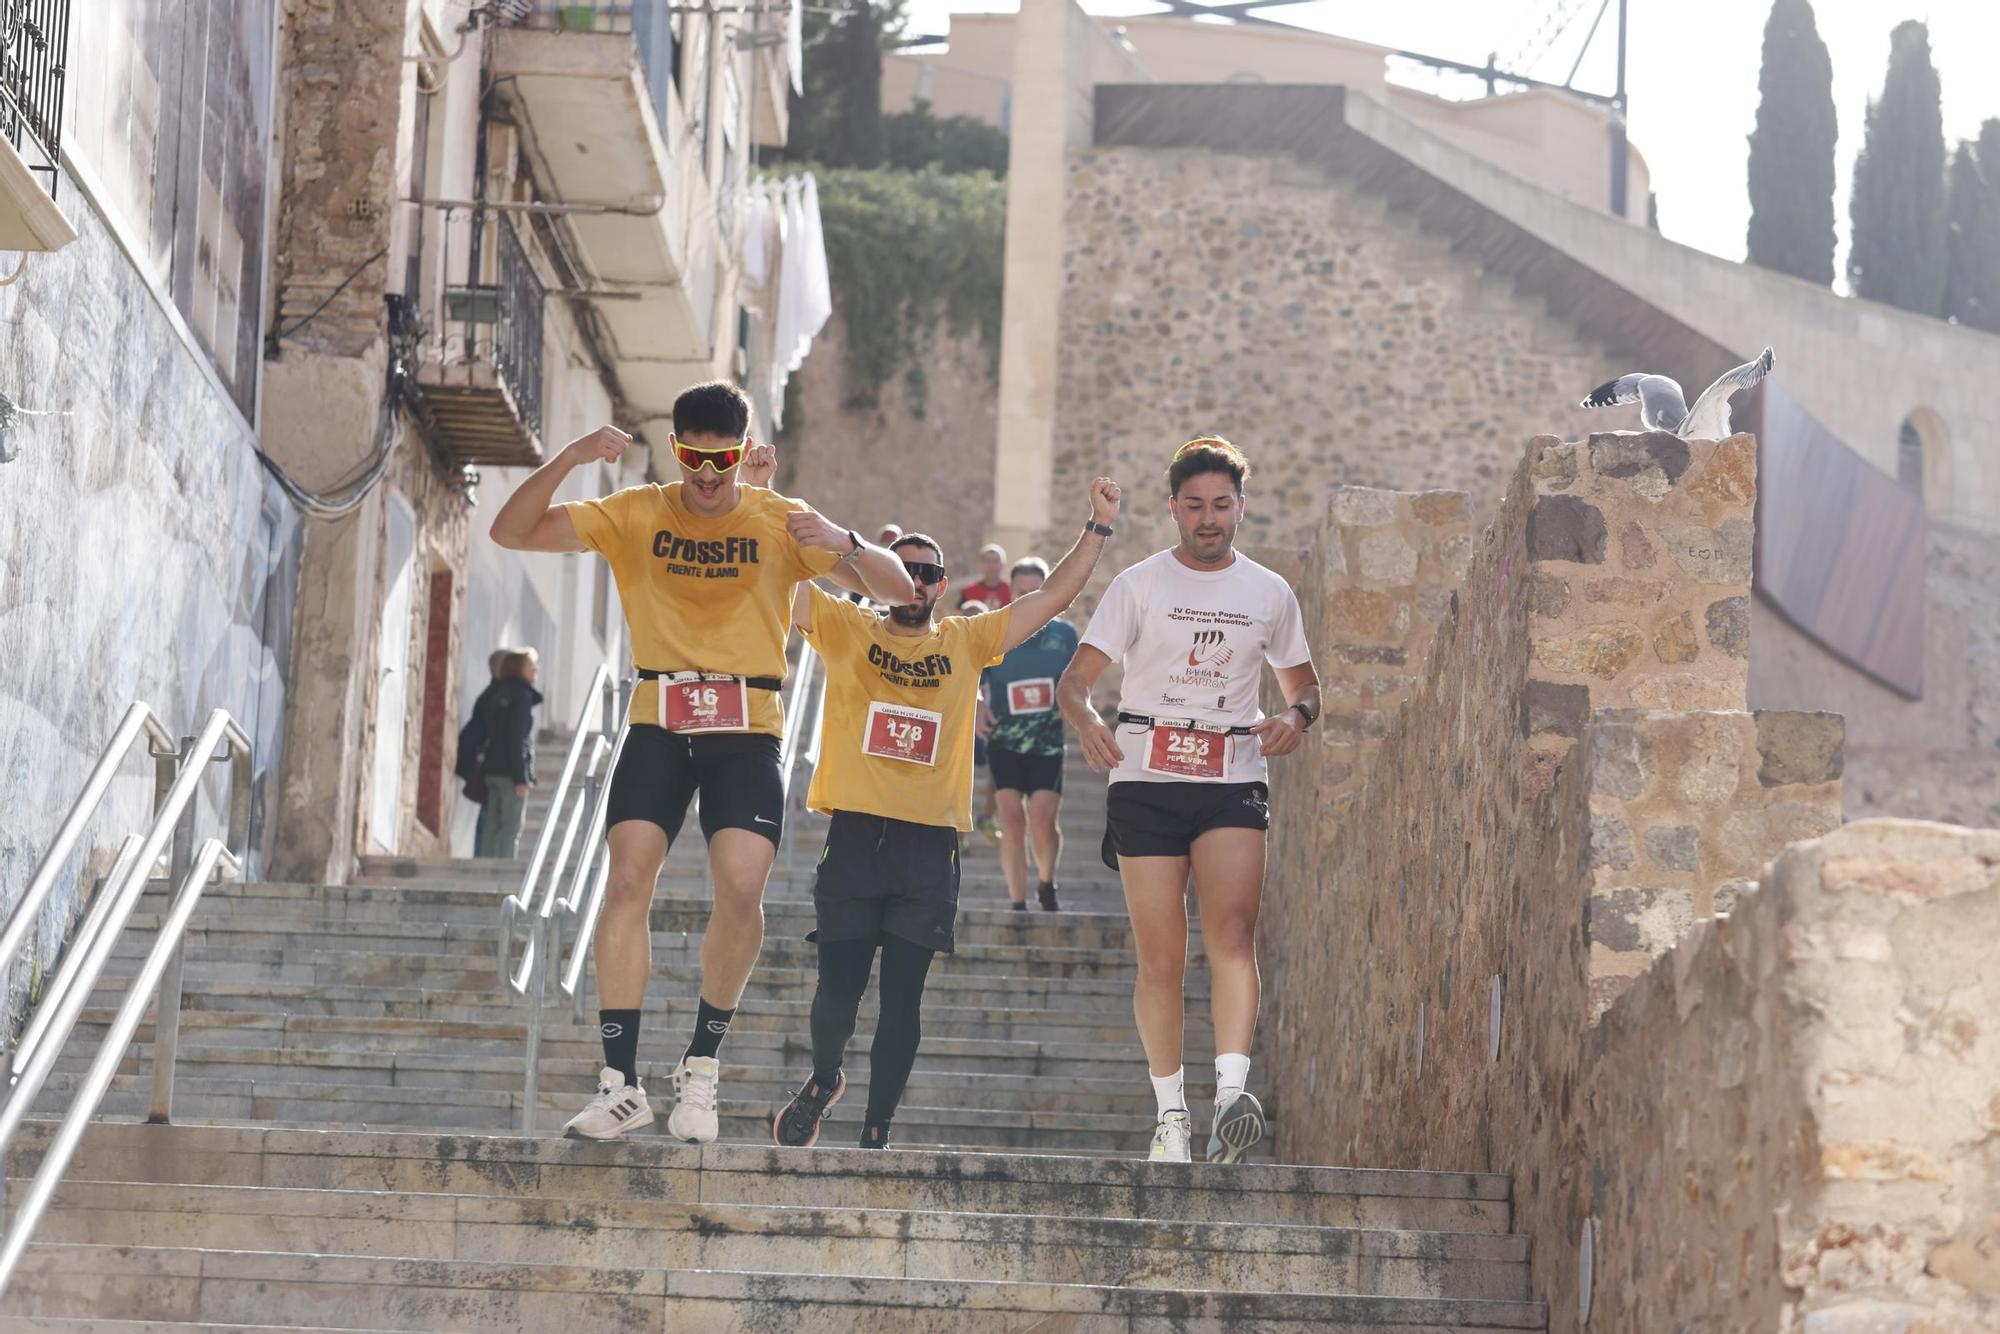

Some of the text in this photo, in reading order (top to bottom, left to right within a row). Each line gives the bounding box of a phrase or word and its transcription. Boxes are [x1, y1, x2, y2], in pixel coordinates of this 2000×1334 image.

[653, 530, 759, 564] CrossFit
[667, 563, 738, 578] FUENTE ALAMO
[1185, 608, 1216, 617] Carrera
[1219, 610, 1249, 620] Popular
[868, 643, 952, 677] CrossFit
[911, 678, 939, 688] ALAMO
[688, 688, 719, 707] 16
[887, 719, 922, 741] 178
